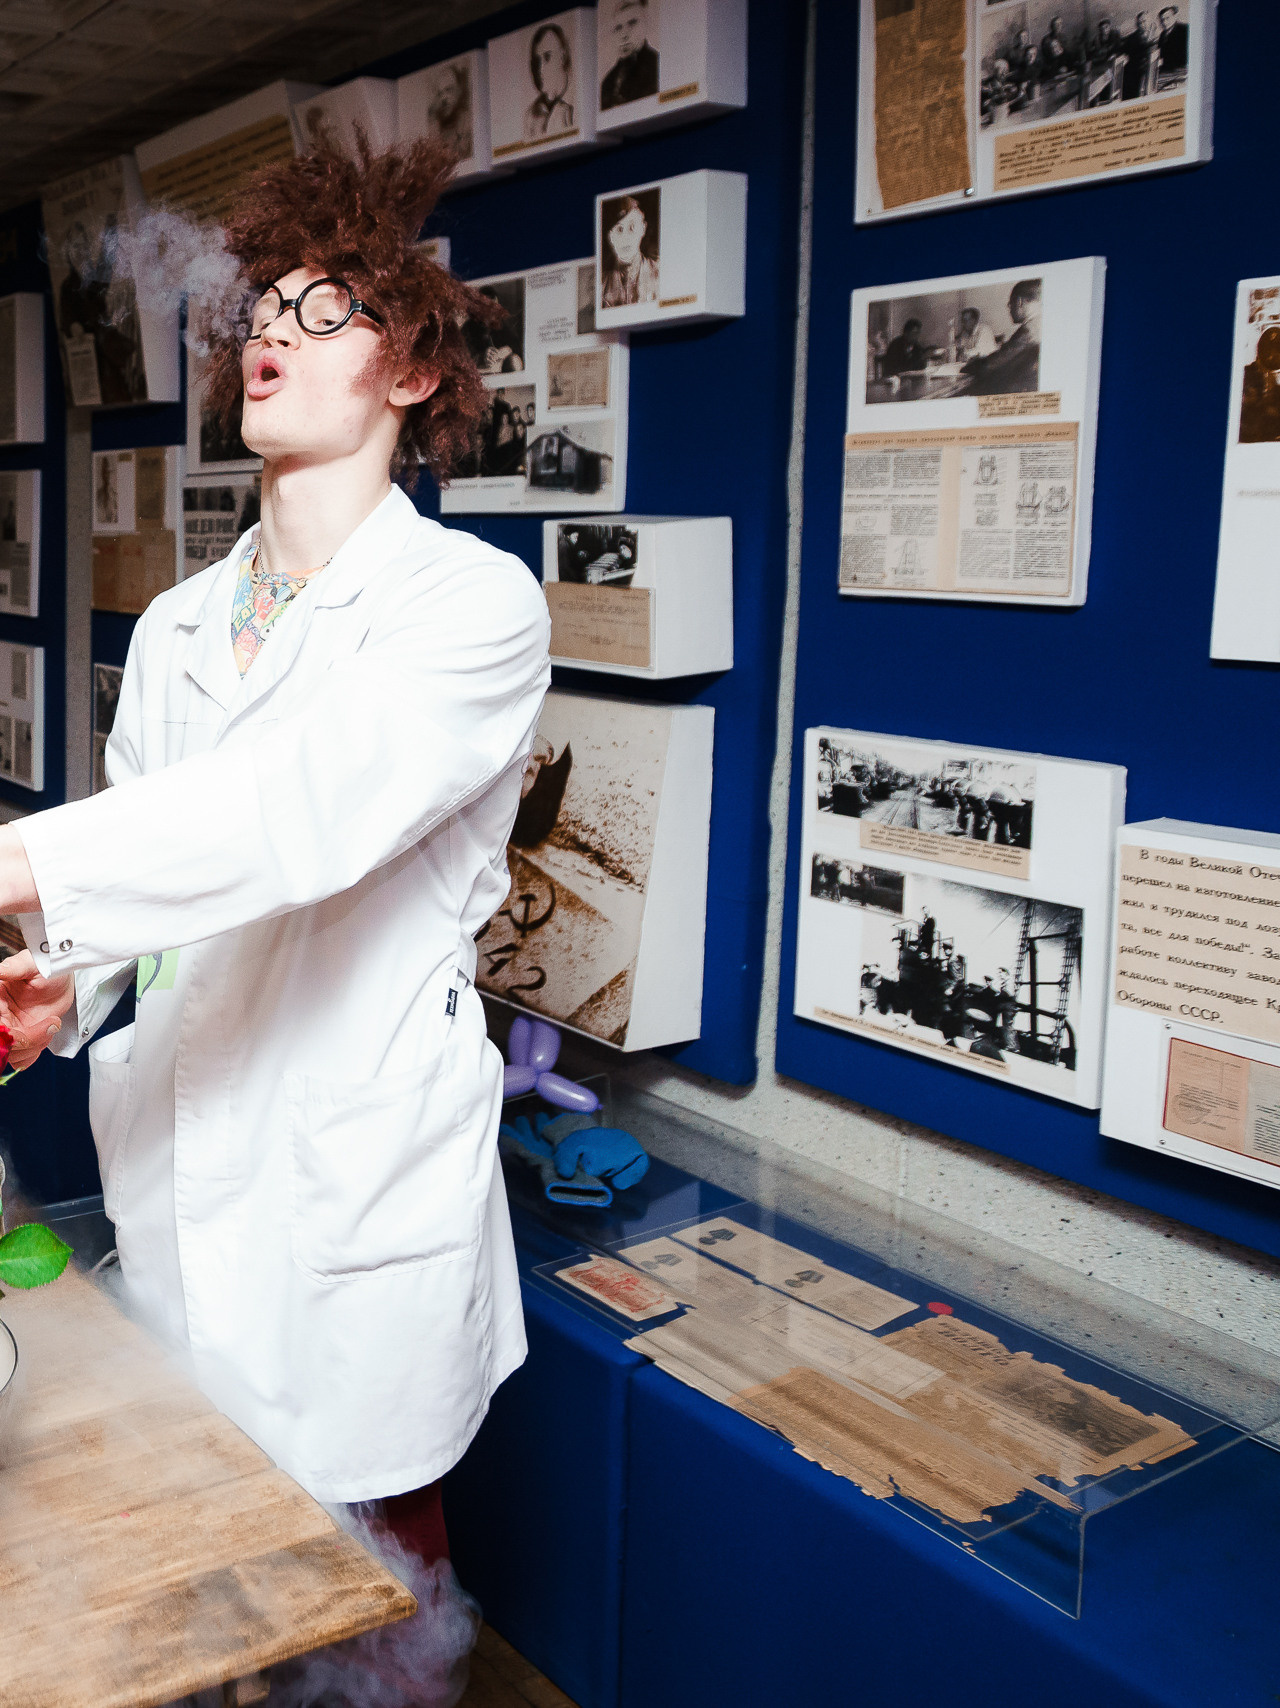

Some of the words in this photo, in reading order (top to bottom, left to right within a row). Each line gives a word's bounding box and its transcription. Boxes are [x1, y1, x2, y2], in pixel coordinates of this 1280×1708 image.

[1139, 849, 1150, 860] В
[1155, 854, 1184, 866] годы
[1189, 856, 1243, 875] Великой
[1122, 873, 1173, 889] перешел
[1175, 882, 1190, 892] на
[1122, 899, 1145, 909] жил
[1150, 903, 1158, 911] и
[1163, 905, 1220, 923] трудился
[1225, 917, 1249, 929] под
[1256, 923, 1280, 938] лоз
[1142, 926, 1163, 937] все
[1168, 932, 1190, 943] для
[1119, 944, 1161, 959] работе
[1166, 955, 1238, 977] коллективу
[1119, 968, 1169, 986] ждалось
[1174, 981, 1259, 1006] переходящее
[1117, 989, 1172, 1012] Обороны
